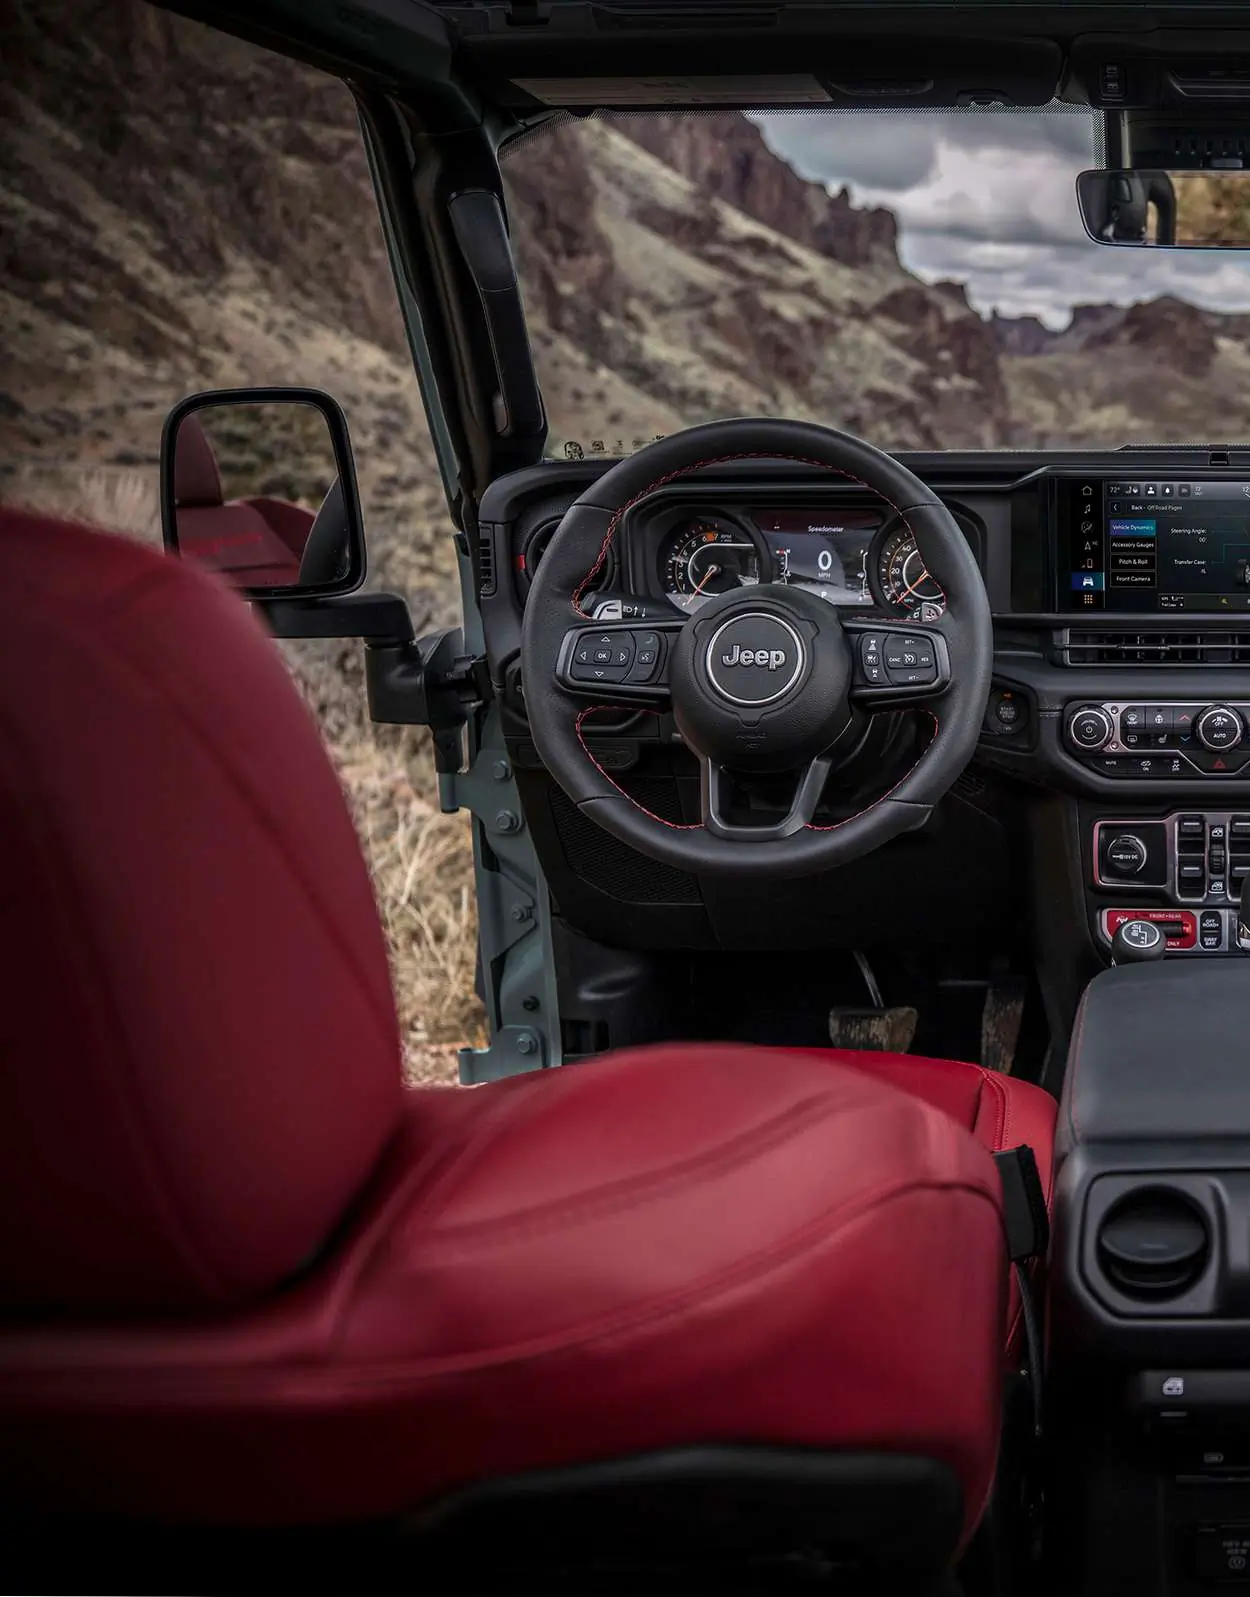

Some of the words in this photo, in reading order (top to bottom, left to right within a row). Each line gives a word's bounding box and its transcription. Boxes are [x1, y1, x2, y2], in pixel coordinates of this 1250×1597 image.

[808, 525, 844, 534] Speedometer
[818, 550, 832, 570] 0
[722, 645, 786, 670] Jeep
